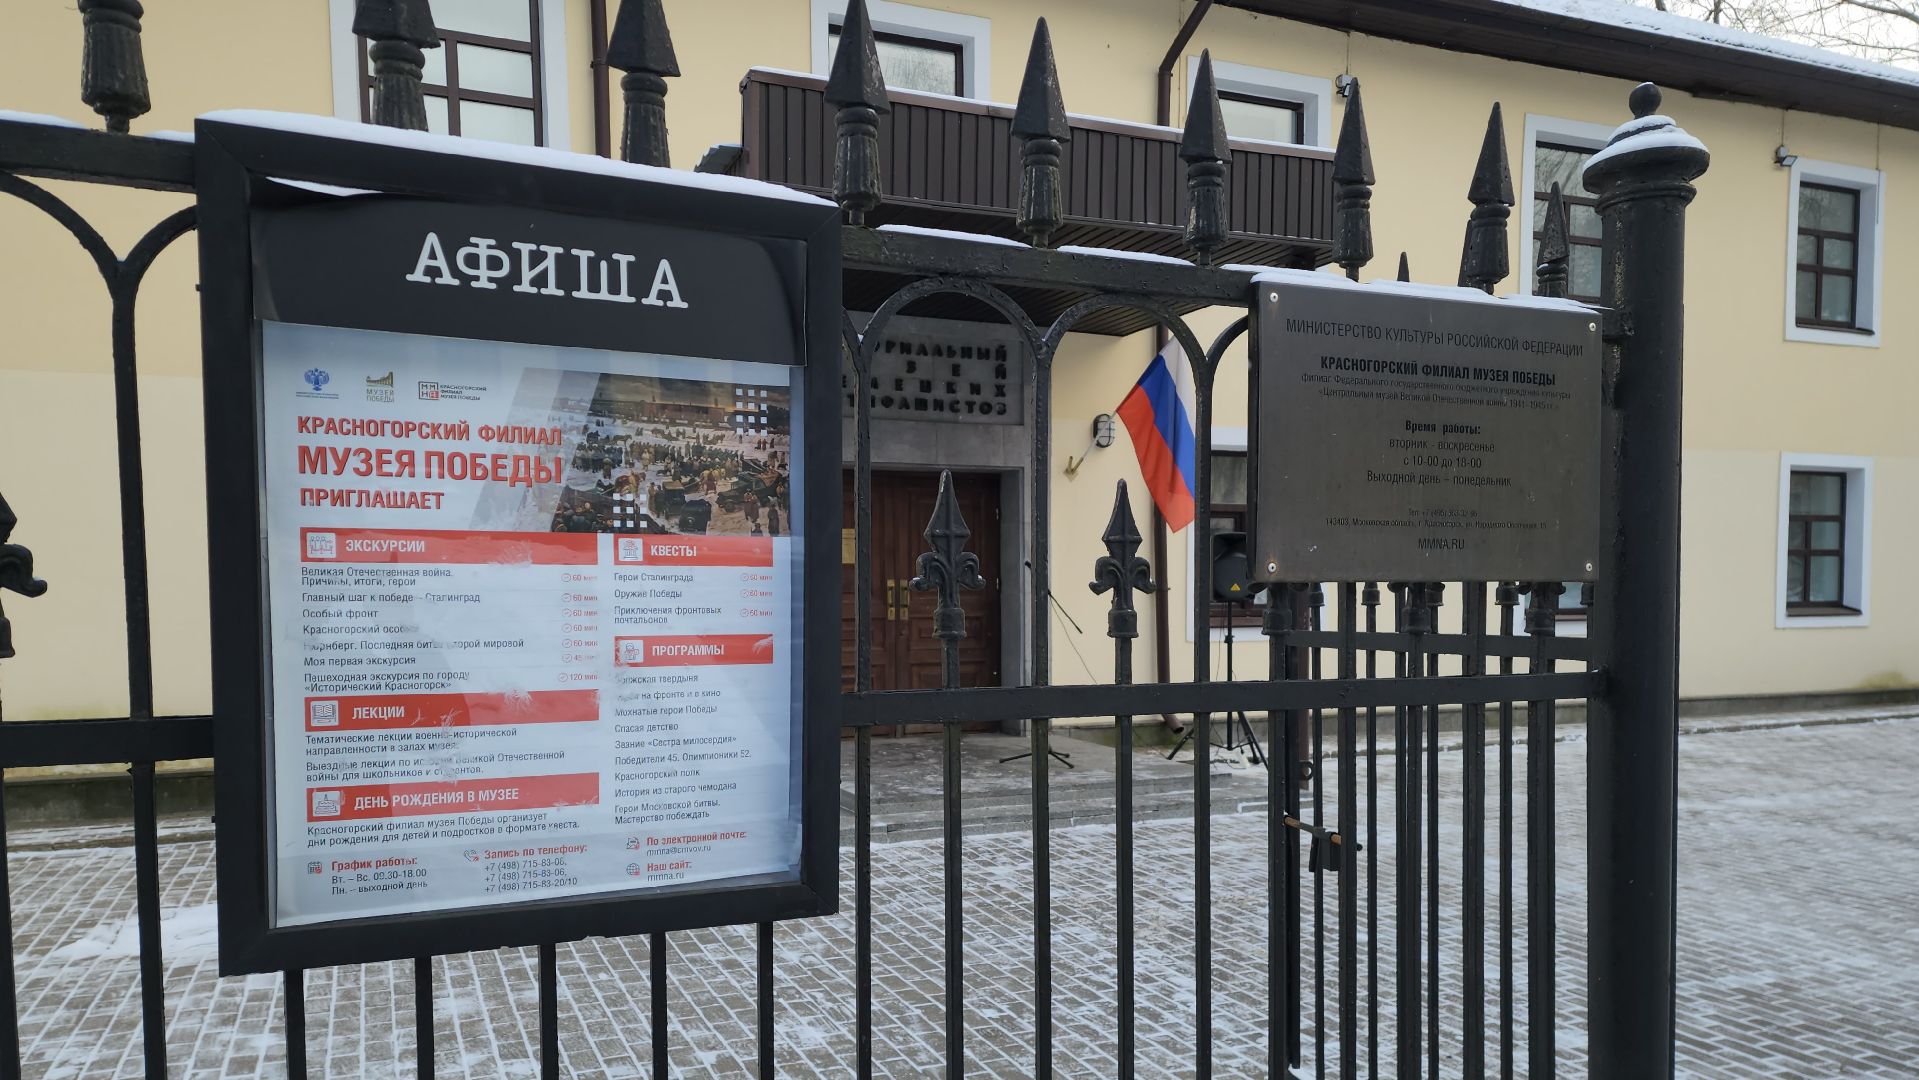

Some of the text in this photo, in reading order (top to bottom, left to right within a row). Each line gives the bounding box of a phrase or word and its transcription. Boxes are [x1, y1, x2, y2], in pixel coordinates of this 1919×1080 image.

[406, 232, 689, 308] АФИША
[1286, 319, 1583, 357] МИНИСТЕРСТВО КУЛЬТУРЫ РОССИЙСКОЙ ФЕДЕРАЦИИ
[874, 341, 1007, 362] РИАЛЬНЫЙ
[1321, 356, 1555, 387] КРАСНОГОРСКИЙ ФИЛИАЛ МУЗЕЯ ПОБЕДЫ
[297, 416, 561, 445] КРАСНОГОРСКИЙ ФИЛИАЛ
[1406, 420, 1480, 435] Время работы:
[1390, 438, 1495, 453] вторник воскресенье
[298, 445, 561, 487] МУЗЕЯ ПОБЕДЫ
[1404, 456, 1481, 468] с 10-00 до 18-00
[1367, 470, 1511, 487] Выходной день понедельник
[301, 488, 444, 509] ПРИГЛАШАЕТ
[346, 540, 425, 552] ЭКСКУРСИИ
[1419, 539, 1464, 550] MMNA.RU
[651, 545, 697, 557] КВЕСТЫ
[302, 567, 453, 576] Великая Отечественная война.
[614, 573, 693, 582] Герои Сталинграда
[355, 578, 385, 586] итоги,
[389, 578, 416, 587] герои
[302, 593, 344, 601] Главный
[350, 594, 367, 602] шаг
[379, 593, 413, 603] победе
[426, 593, 480, 603] Сталинград
[615, 590, 682, 599] Оружие Победы
[303, 609, 378, 619] Особый фронт
[615, 606, 721, 616] Приключения фронтовых
[615, 616, 667, 624] почтальонов
[303, 625, 379, 635] Красногорский
[361, 639, 524, 650] Последняя мировой
[652, 645, 724, 656] ПРОГРАММЫ
[304, 656, 416, 667] Моя первая экскурсия
[305, 673, 367, 683] Пешеходная
[370, 672, 419, 681] экскурсия
[437, 671, 469, 680] городу
[659, 675, 698, 684] твердыня
[305, 681, 451, 693] «Исторический Красногорск»
[642, 691, 650, 700] на
[654, 691, 684, 700] фронте
[352, 706, 405, 719] ЛЕКЦИИ
[615, 705, 717, 716] Мохнатые герои Победы
[615, 723, 678, 733] Спасая детство
[306, 733, 412, 744] Тематические лекции
[616, 736, 736, 749] Звание «Сестра милосердия»
[306, 743, 425, 756] направленности залах
[498, 751, 565, 762] Отечественной
[615, 750, 751, 766] Победители 45. Олимпионики 52.
[361, 758, 395, 769] лекции
[307, 768, 422, 782] войны для школьников
[615, 769, 677, 783] Красногорский
[615, 788, 649, 798] История
[665, 785, 695, 794] старого
[699, 782, 736, 791] чемодана
[355, 788, 519, 810] ДЕНЬ РОЖДЕНИЯ В МУЗЕЕ
[615, 799, 720, 814] Герои Московской битвы.
[615, 811, 709, 825] Мастерство побеждать
[308, 813, 547, 836] Красногорский филиал музея Победы организует
[308, 839, 326, 848] дни
[330, 835, 378, 847] рождения
[382, 834, 398, 843] для
[402, 830, 429, 841] детей
[441, 827, 494, 838] подростков
[506, 823, 546, 834] формате
[647, 831, 746, 846] По электронной почте:
[484, 844, 587, 860] Запись по телефону:
[332, 860, 372, 872] График
[485, 860, 519, 872] +7 (498)
[647, 863, 666, 872] Наш
[332, 876, 345, 884] Вт.
[357, 873, 370, 882] Вс.
[485, 874, 495, 882] +7
[498, 871, 519, 882] (498)
[647, 873, 684, 883] mmna.ru
[332, 881, 428, 895] Пн. выходной день
[485, 884, 495, 893] +7
[498, 881, 519, 893] (498)
